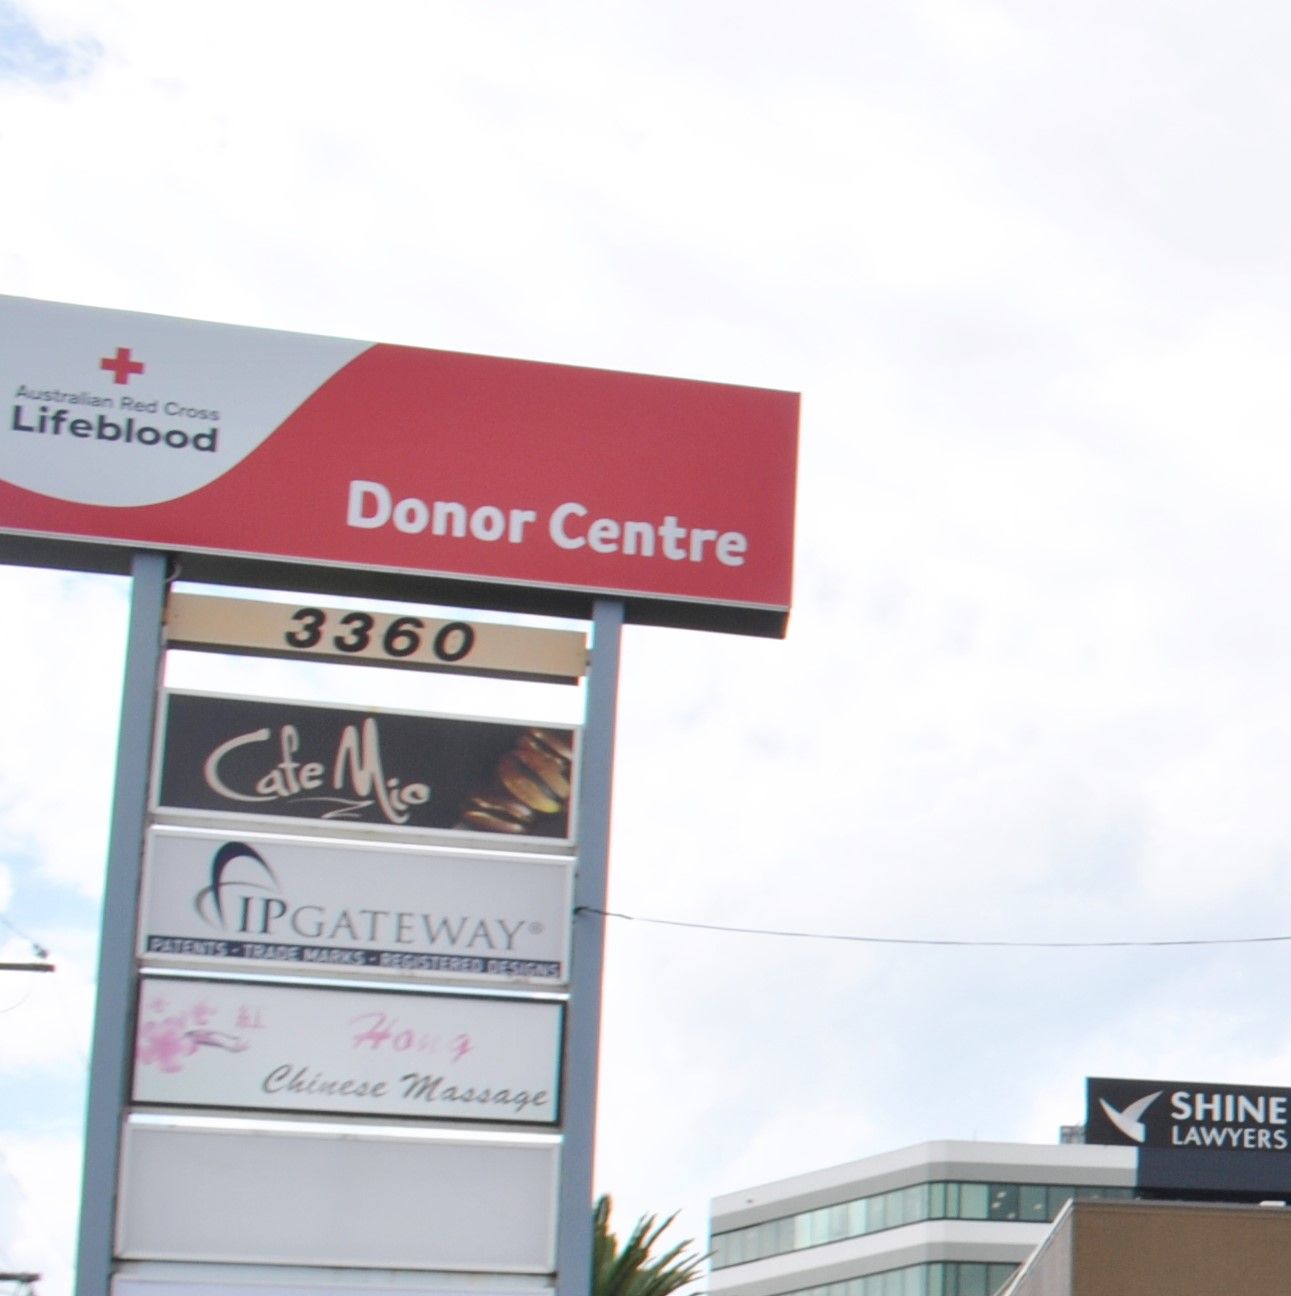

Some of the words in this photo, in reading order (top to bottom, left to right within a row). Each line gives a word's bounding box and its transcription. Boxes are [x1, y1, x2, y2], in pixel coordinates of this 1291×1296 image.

[15, 384, 112, 410] Australian
[120, 395, 159, 416] Red
[165, 400, 221, 422] Cross
[11, 405, 220, 453] Lifeblood
[347, 479, 536, 544] Donor
[549, 502, 748, 567] Centre
[285, 607, 475, 662] 3360
[205, 724, 324, 803] Cafe
[333, 718, 431, 824] Mio
[151, 938, 227, 956] PATENTS
[244, 944, 299, 961] TRADE
[303, 948, 366, 966] MARKS
[379, 952, 484, 973] REGISTERED
[262, 1064, 388, 1098] Chinese
[401, 1072, 549, 1112] Massage
[1171, 1091, 1287, 1125] SHINE
[1171, 1125, 1288, 1149] LAWYERS
